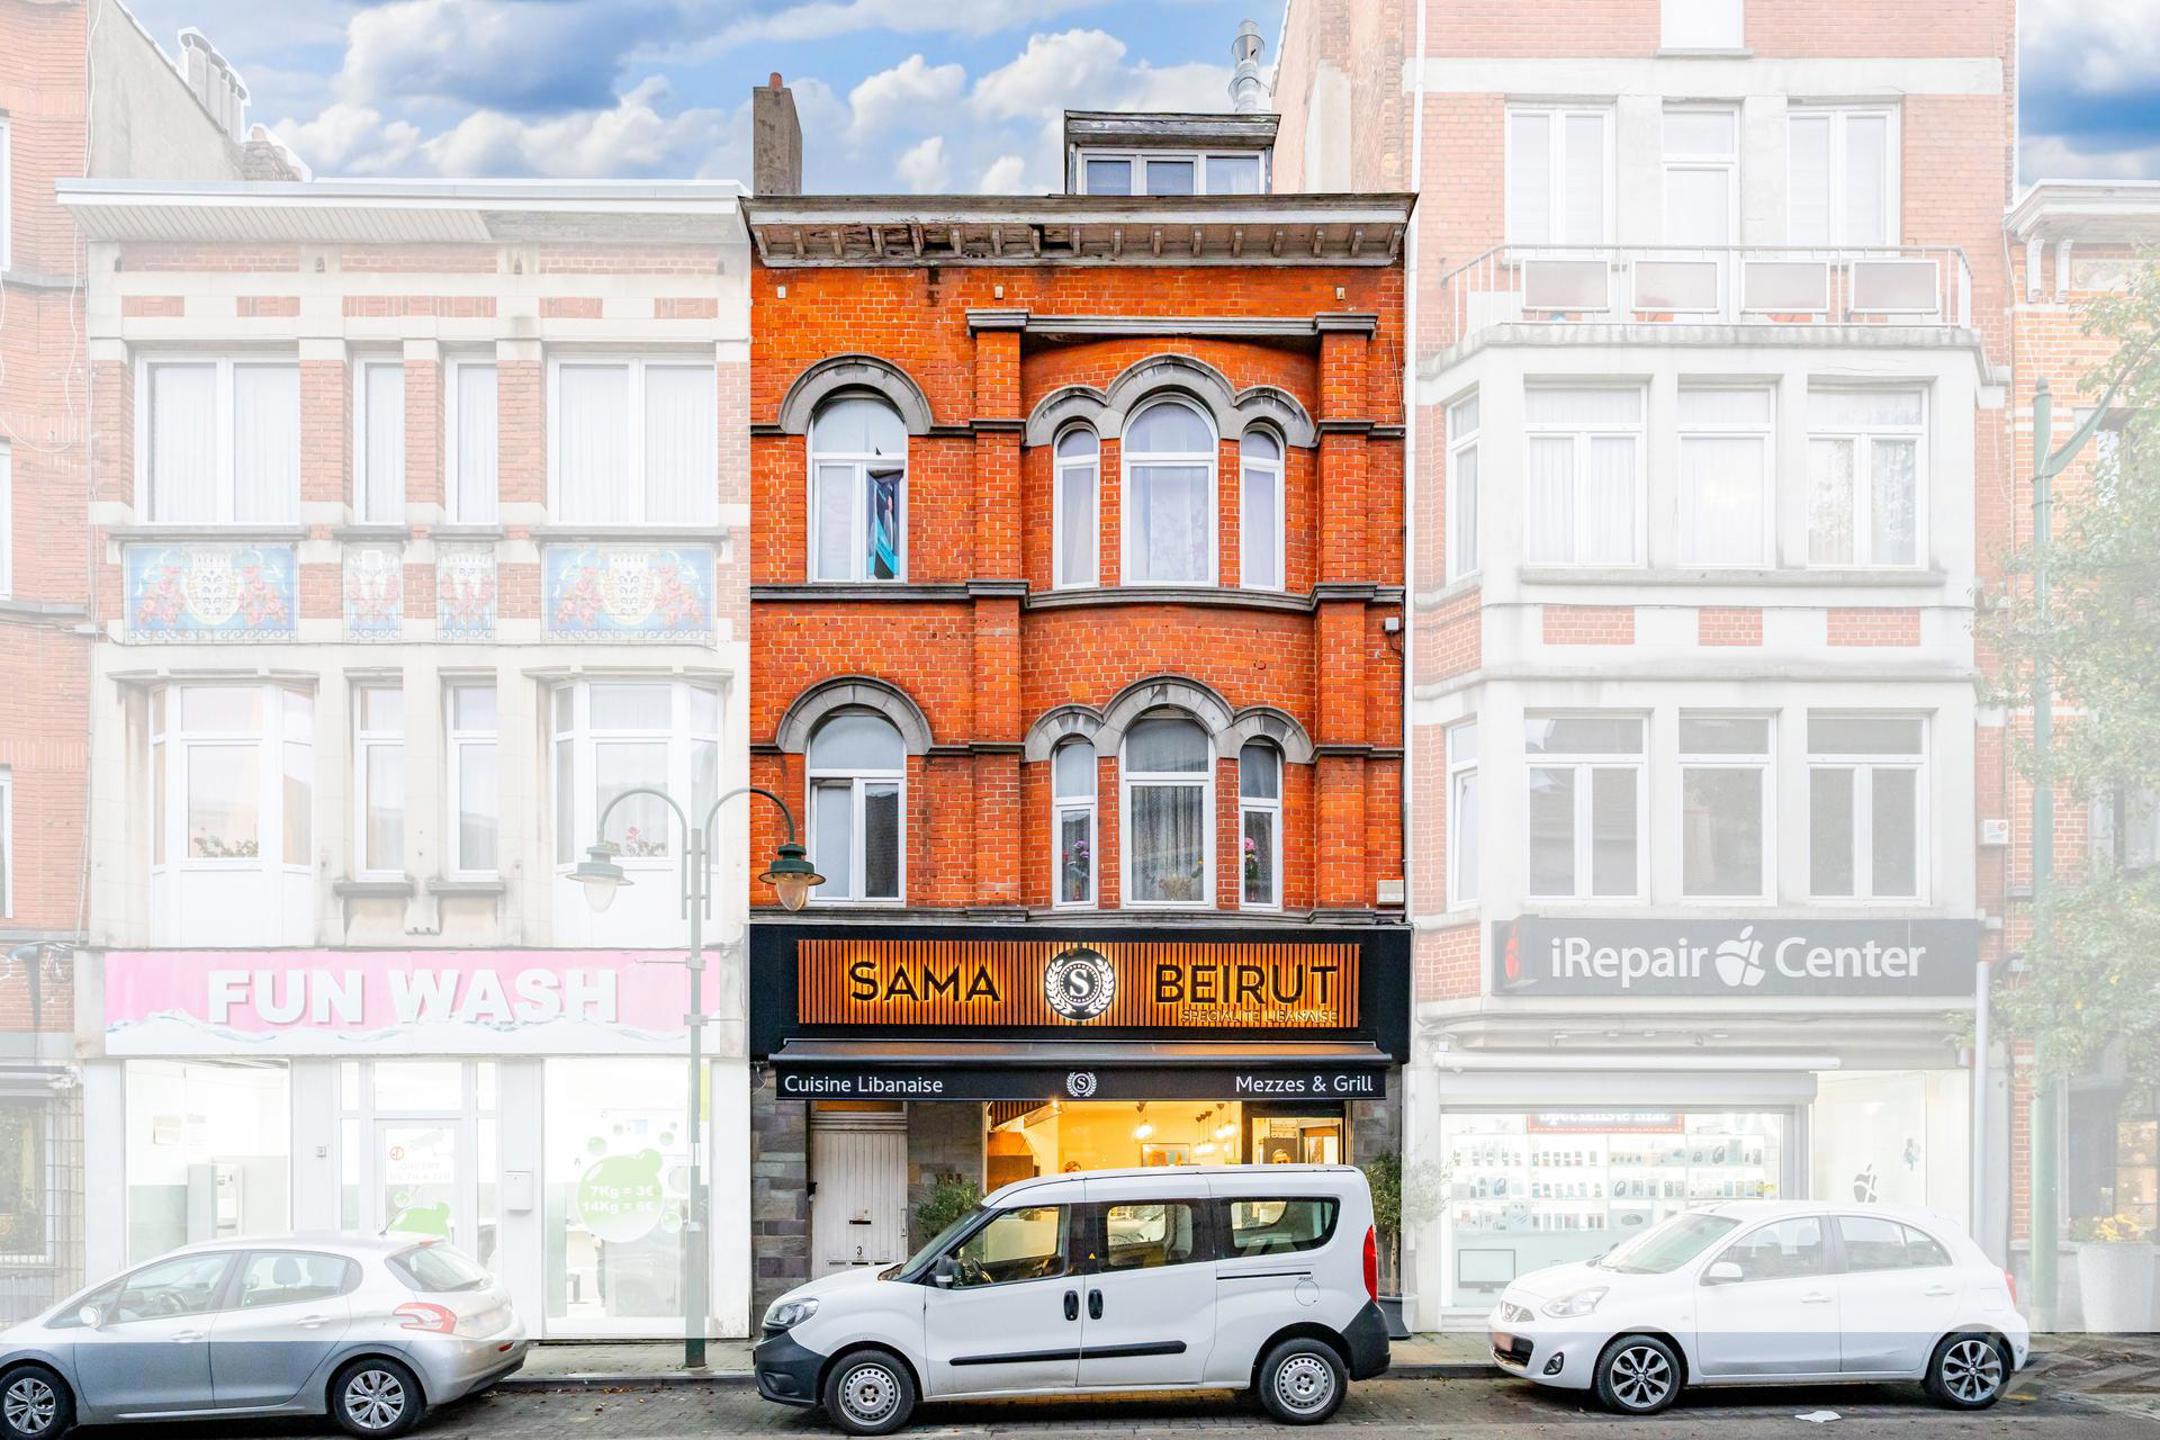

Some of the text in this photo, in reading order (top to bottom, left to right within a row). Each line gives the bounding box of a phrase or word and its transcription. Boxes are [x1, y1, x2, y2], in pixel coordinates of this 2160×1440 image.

[1551, 936, 1927, 989] iRepair Center
[849, 961, 1338, 1004] SAMA BEIRUT
[207, 968, 620, 1025] FUN WASH
[1264, 1008, 1338, 1023] LIBANAISE
[784, 1075, 944, 1093] Cuisine Libanaise
[1235, 1075, 1375, 1093] Mezzes & Grill
[856, 1245, 863, 1256] 3
